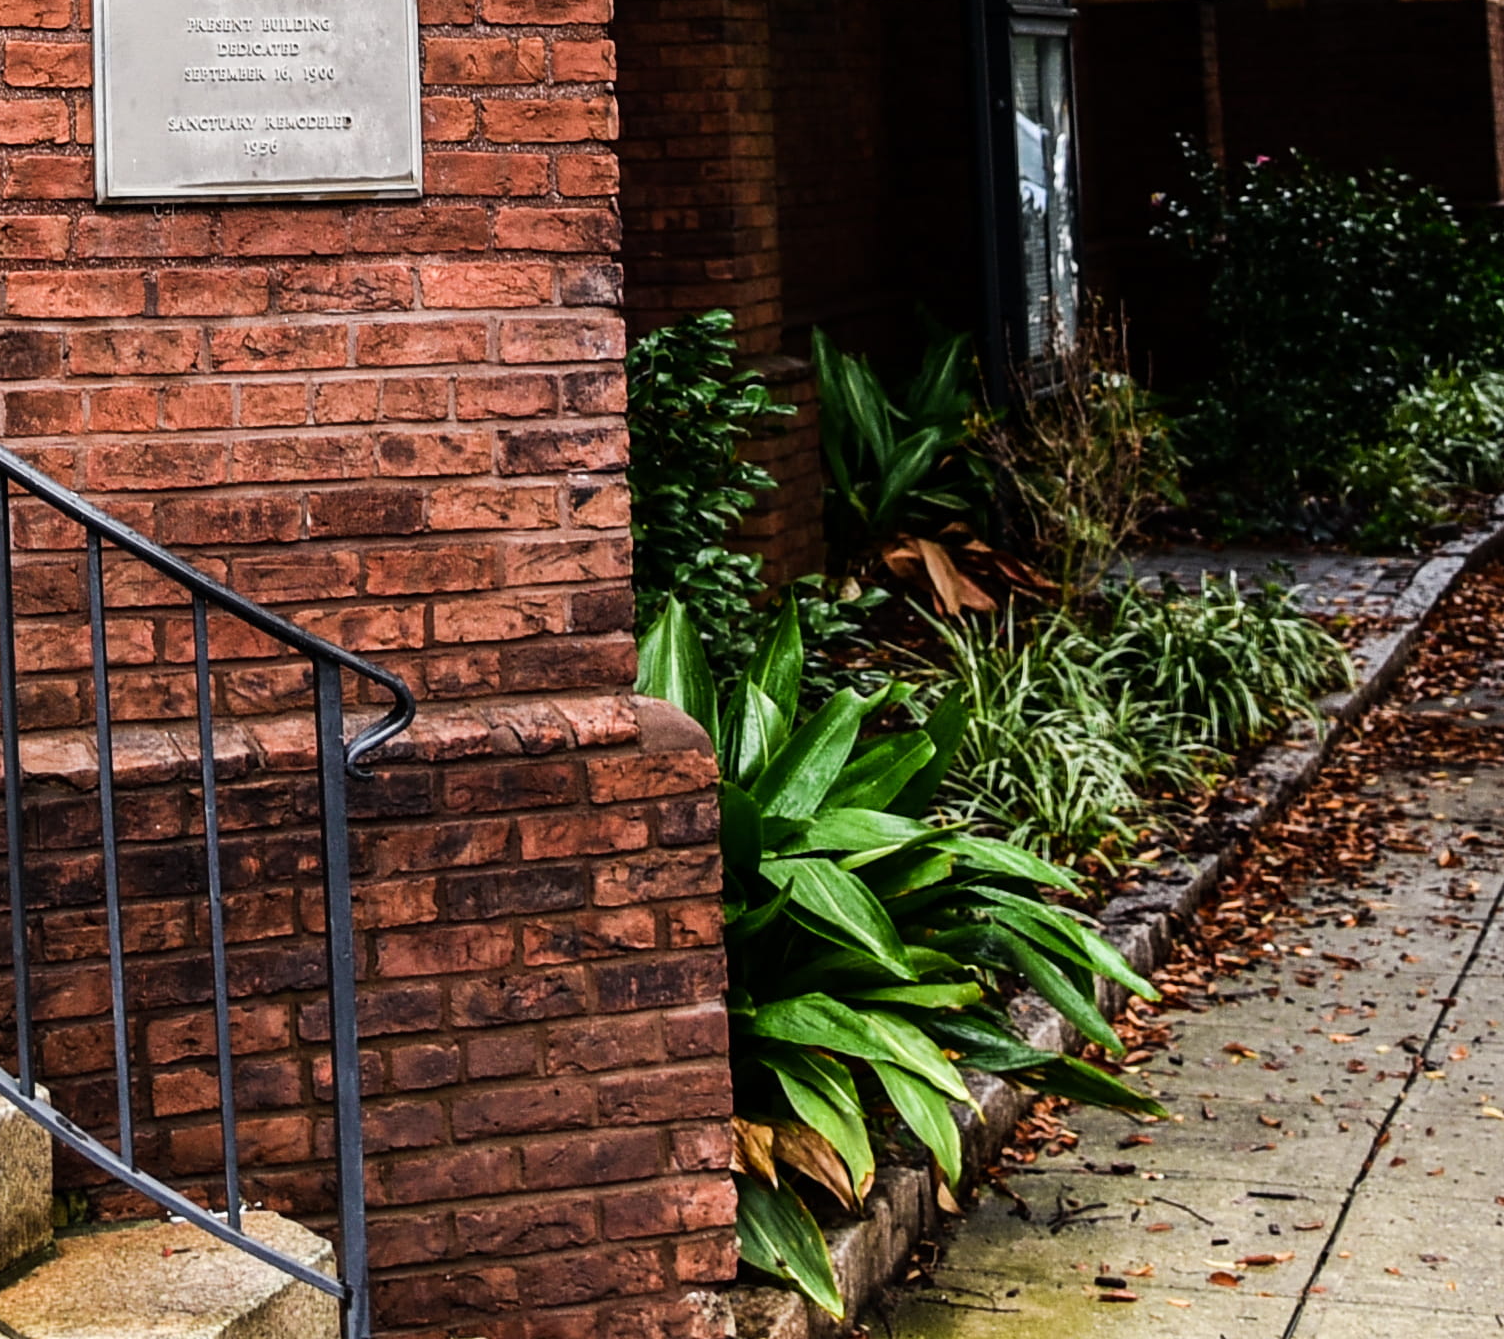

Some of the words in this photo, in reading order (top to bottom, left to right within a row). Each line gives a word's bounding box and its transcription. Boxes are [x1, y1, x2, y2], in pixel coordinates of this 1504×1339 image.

[186, 18, 253, 33] PRESENT
[262, 18, 331, 32] BUILDING
[217, 43, 300, 57] DEDICATED
[184, 67, 266, 82] SEPTEMBER
[303, 67, 335, 84] 1900
[167, 117, 257, 132] SANCTUARY
[265, 115, 352, 131] REMODELED
[243, 138, 278, 156] 1956
